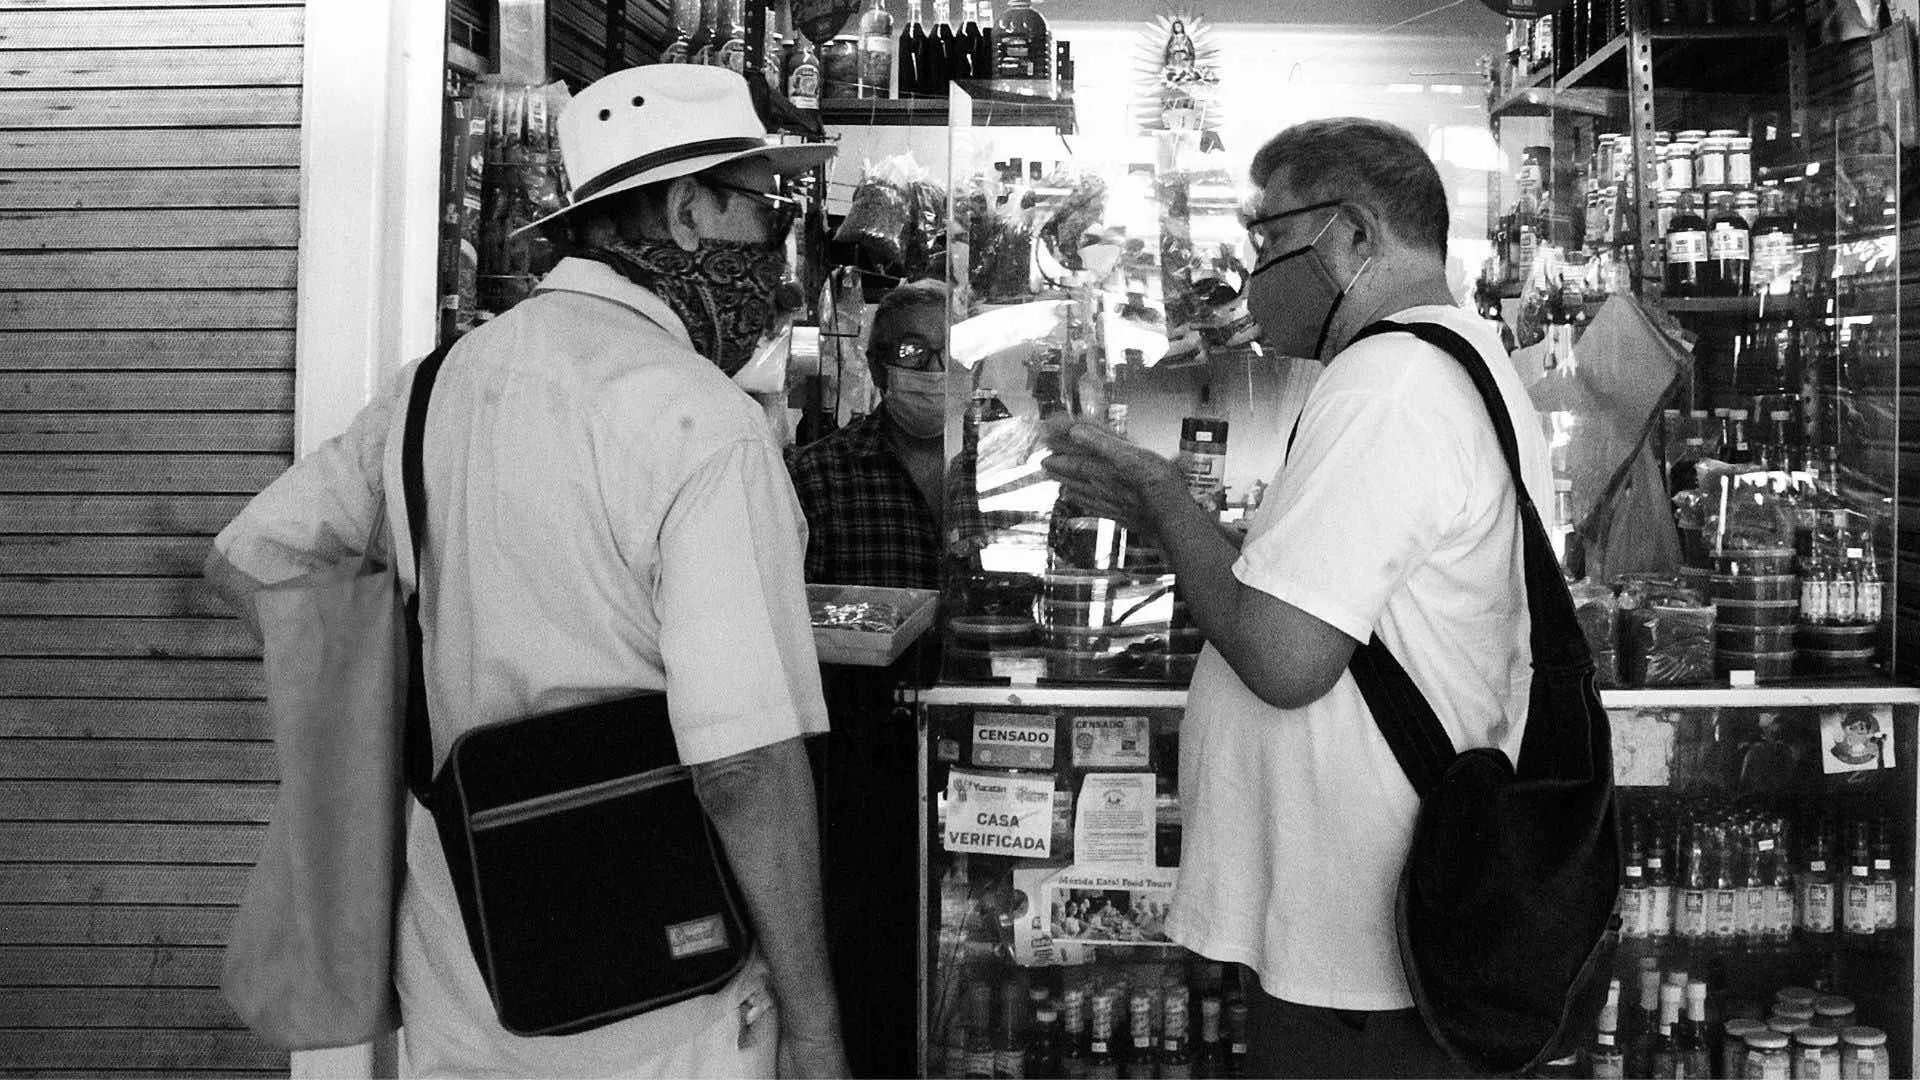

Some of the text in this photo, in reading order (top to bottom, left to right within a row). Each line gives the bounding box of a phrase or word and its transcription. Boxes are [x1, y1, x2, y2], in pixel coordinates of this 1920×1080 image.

[1075, 720, 1124, 729] CENSADO
[978, 728, 1049, 743] CENSADO
[977, 812, 1019, 827] CASA
[949, 831, 1046, 851] VERIFICADA
